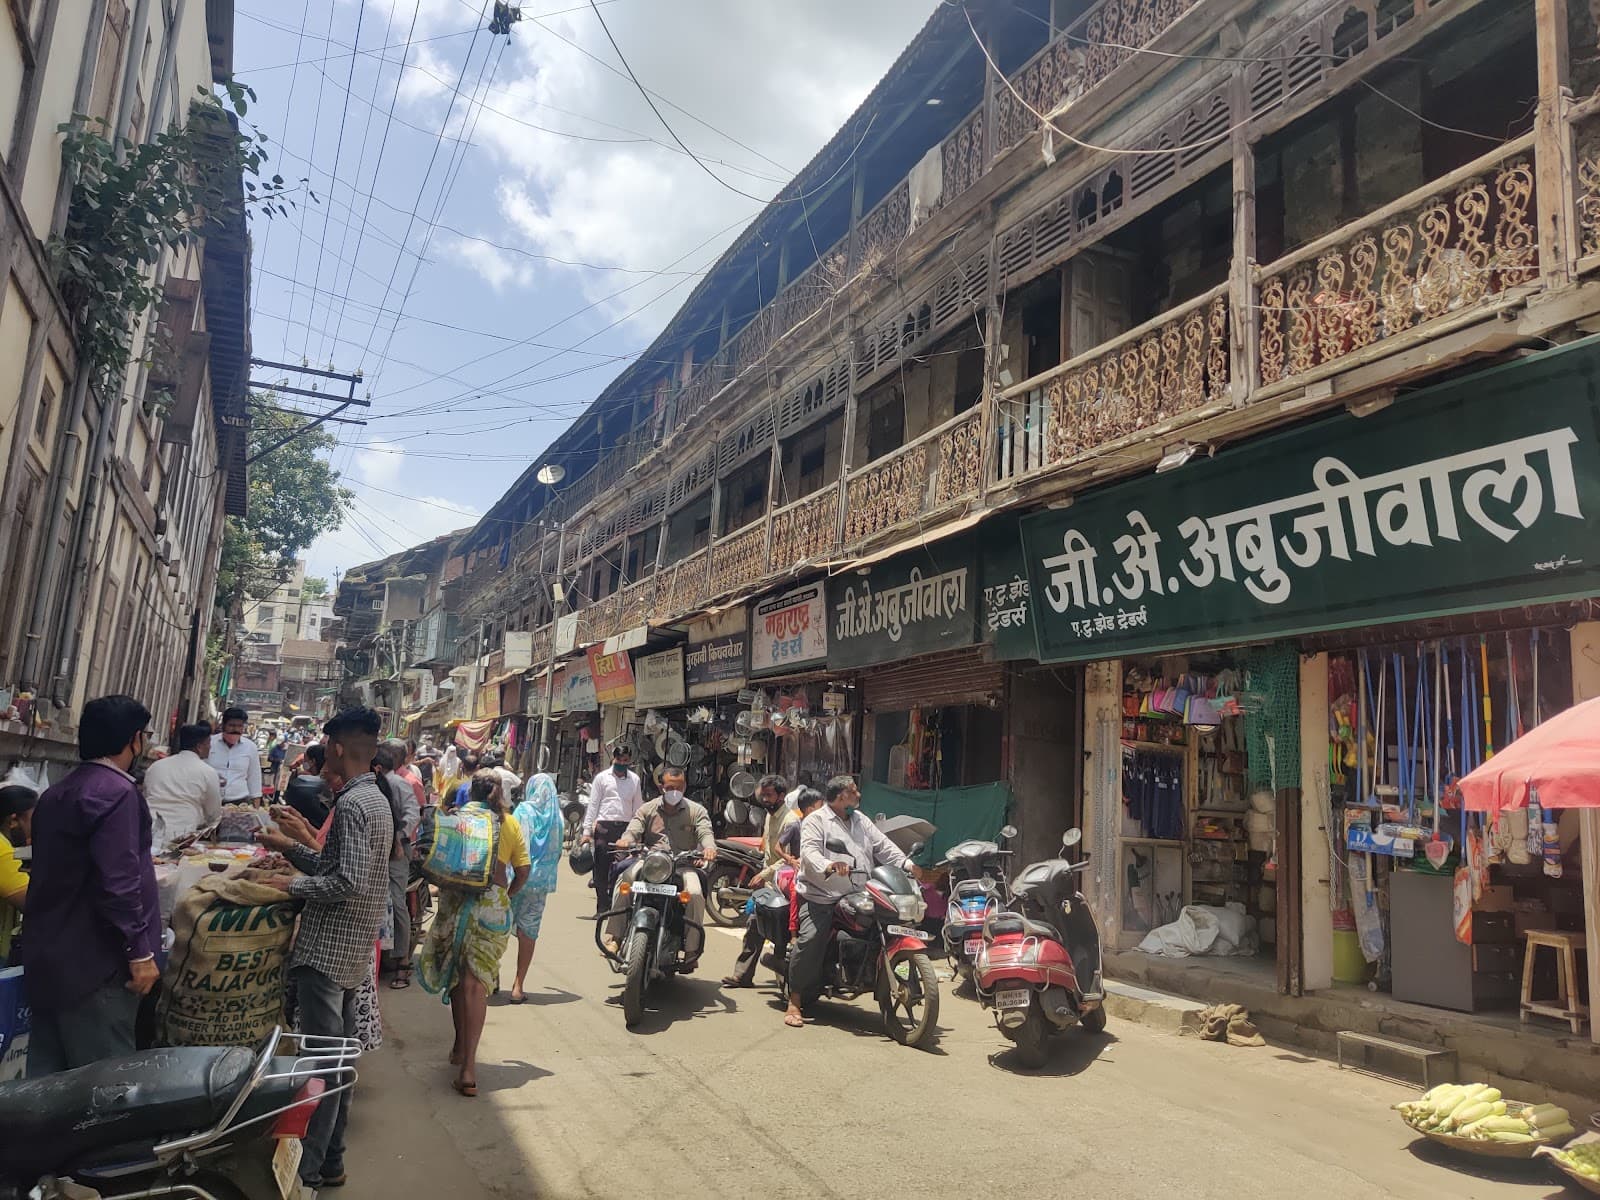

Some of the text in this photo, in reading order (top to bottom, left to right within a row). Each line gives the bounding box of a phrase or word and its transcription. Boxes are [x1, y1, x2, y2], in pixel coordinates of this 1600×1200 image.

[987, 601, 1027, 632] ट्रेडर्स
[1117, 605, 1148, 630] ट्रेडर्स
[216, 950, 275, 971] BEST
[213, 1018, 259, 1032] TRADING
